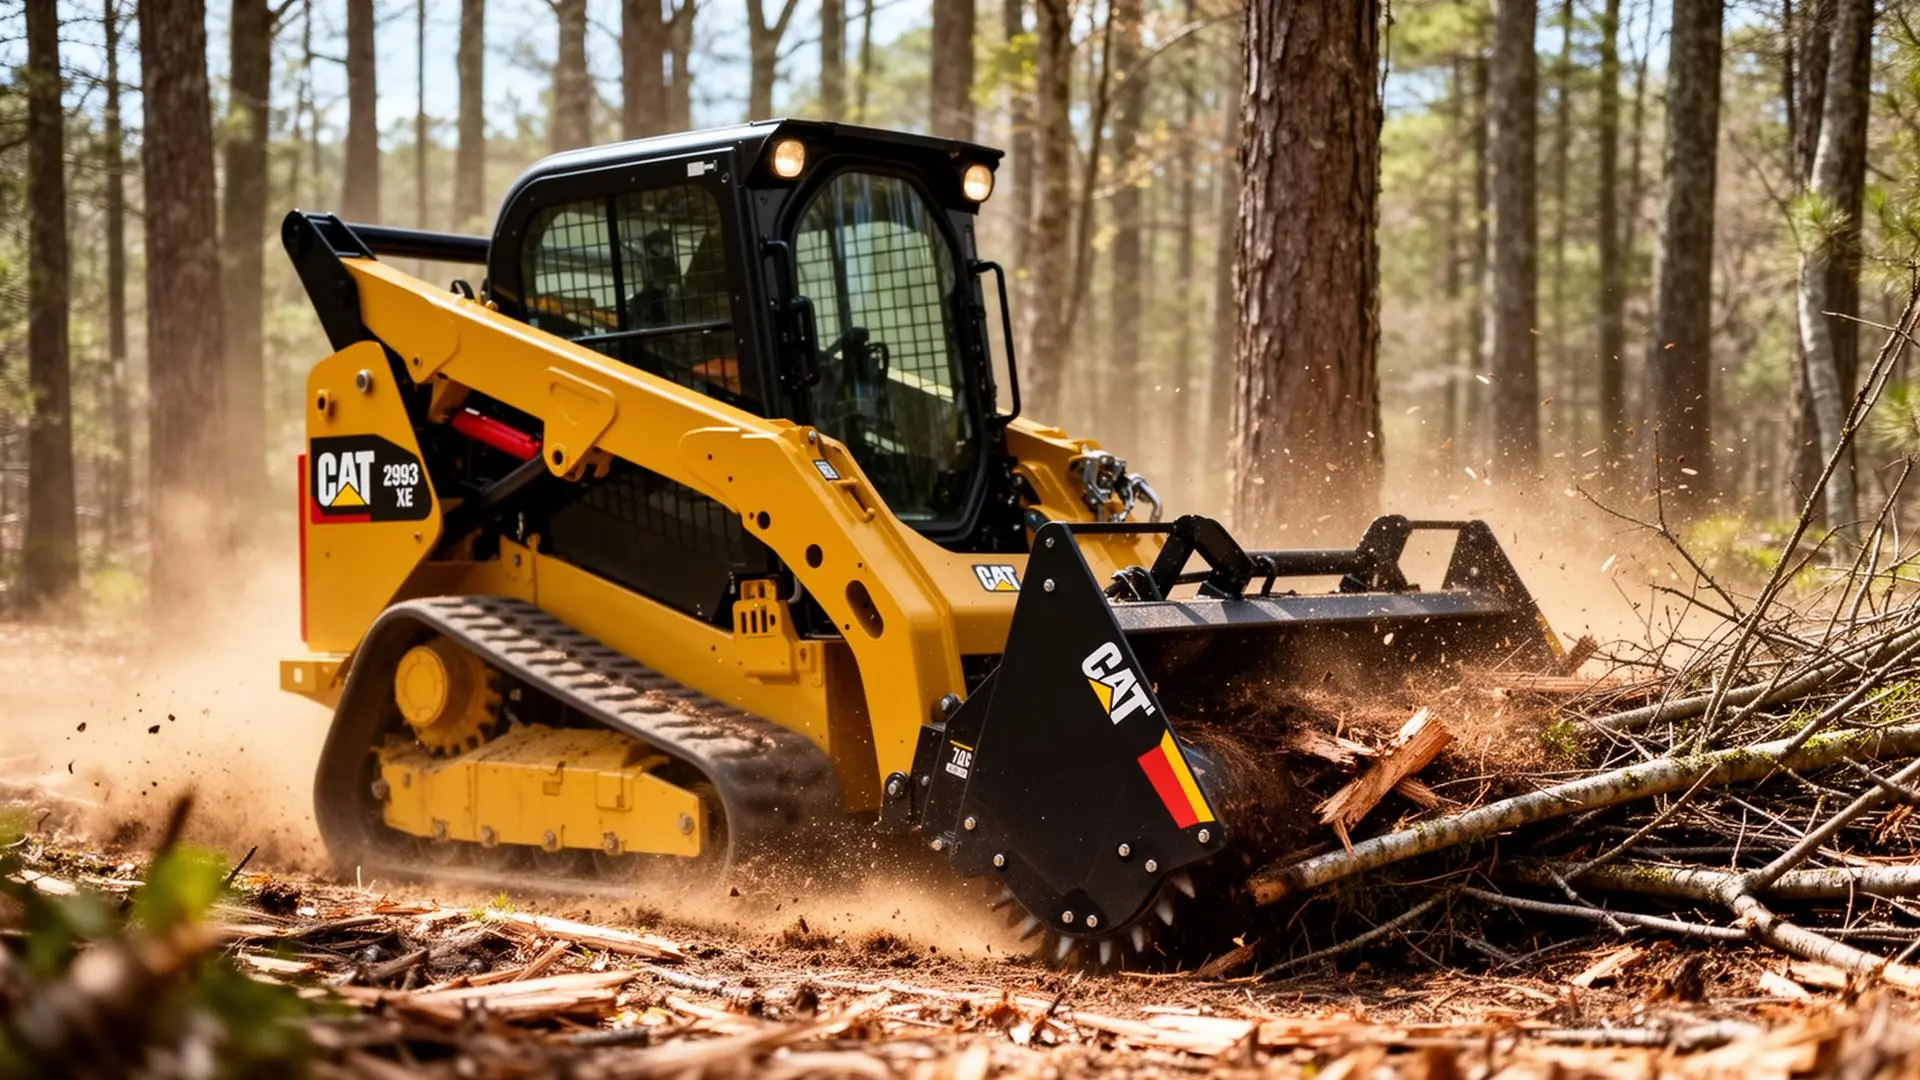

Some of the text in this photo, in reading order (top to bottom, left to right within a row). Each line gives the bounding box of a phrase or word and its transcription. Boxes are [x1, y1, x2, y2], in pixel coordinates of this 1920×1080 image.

[318, 450, 375, 507] CAT
[383, 462, 419, 487] 2993
[396, 487, 413, 508] XE
[975, 565, 1021, 591] CAT
[1081, 641, 1153, 725] CAT
